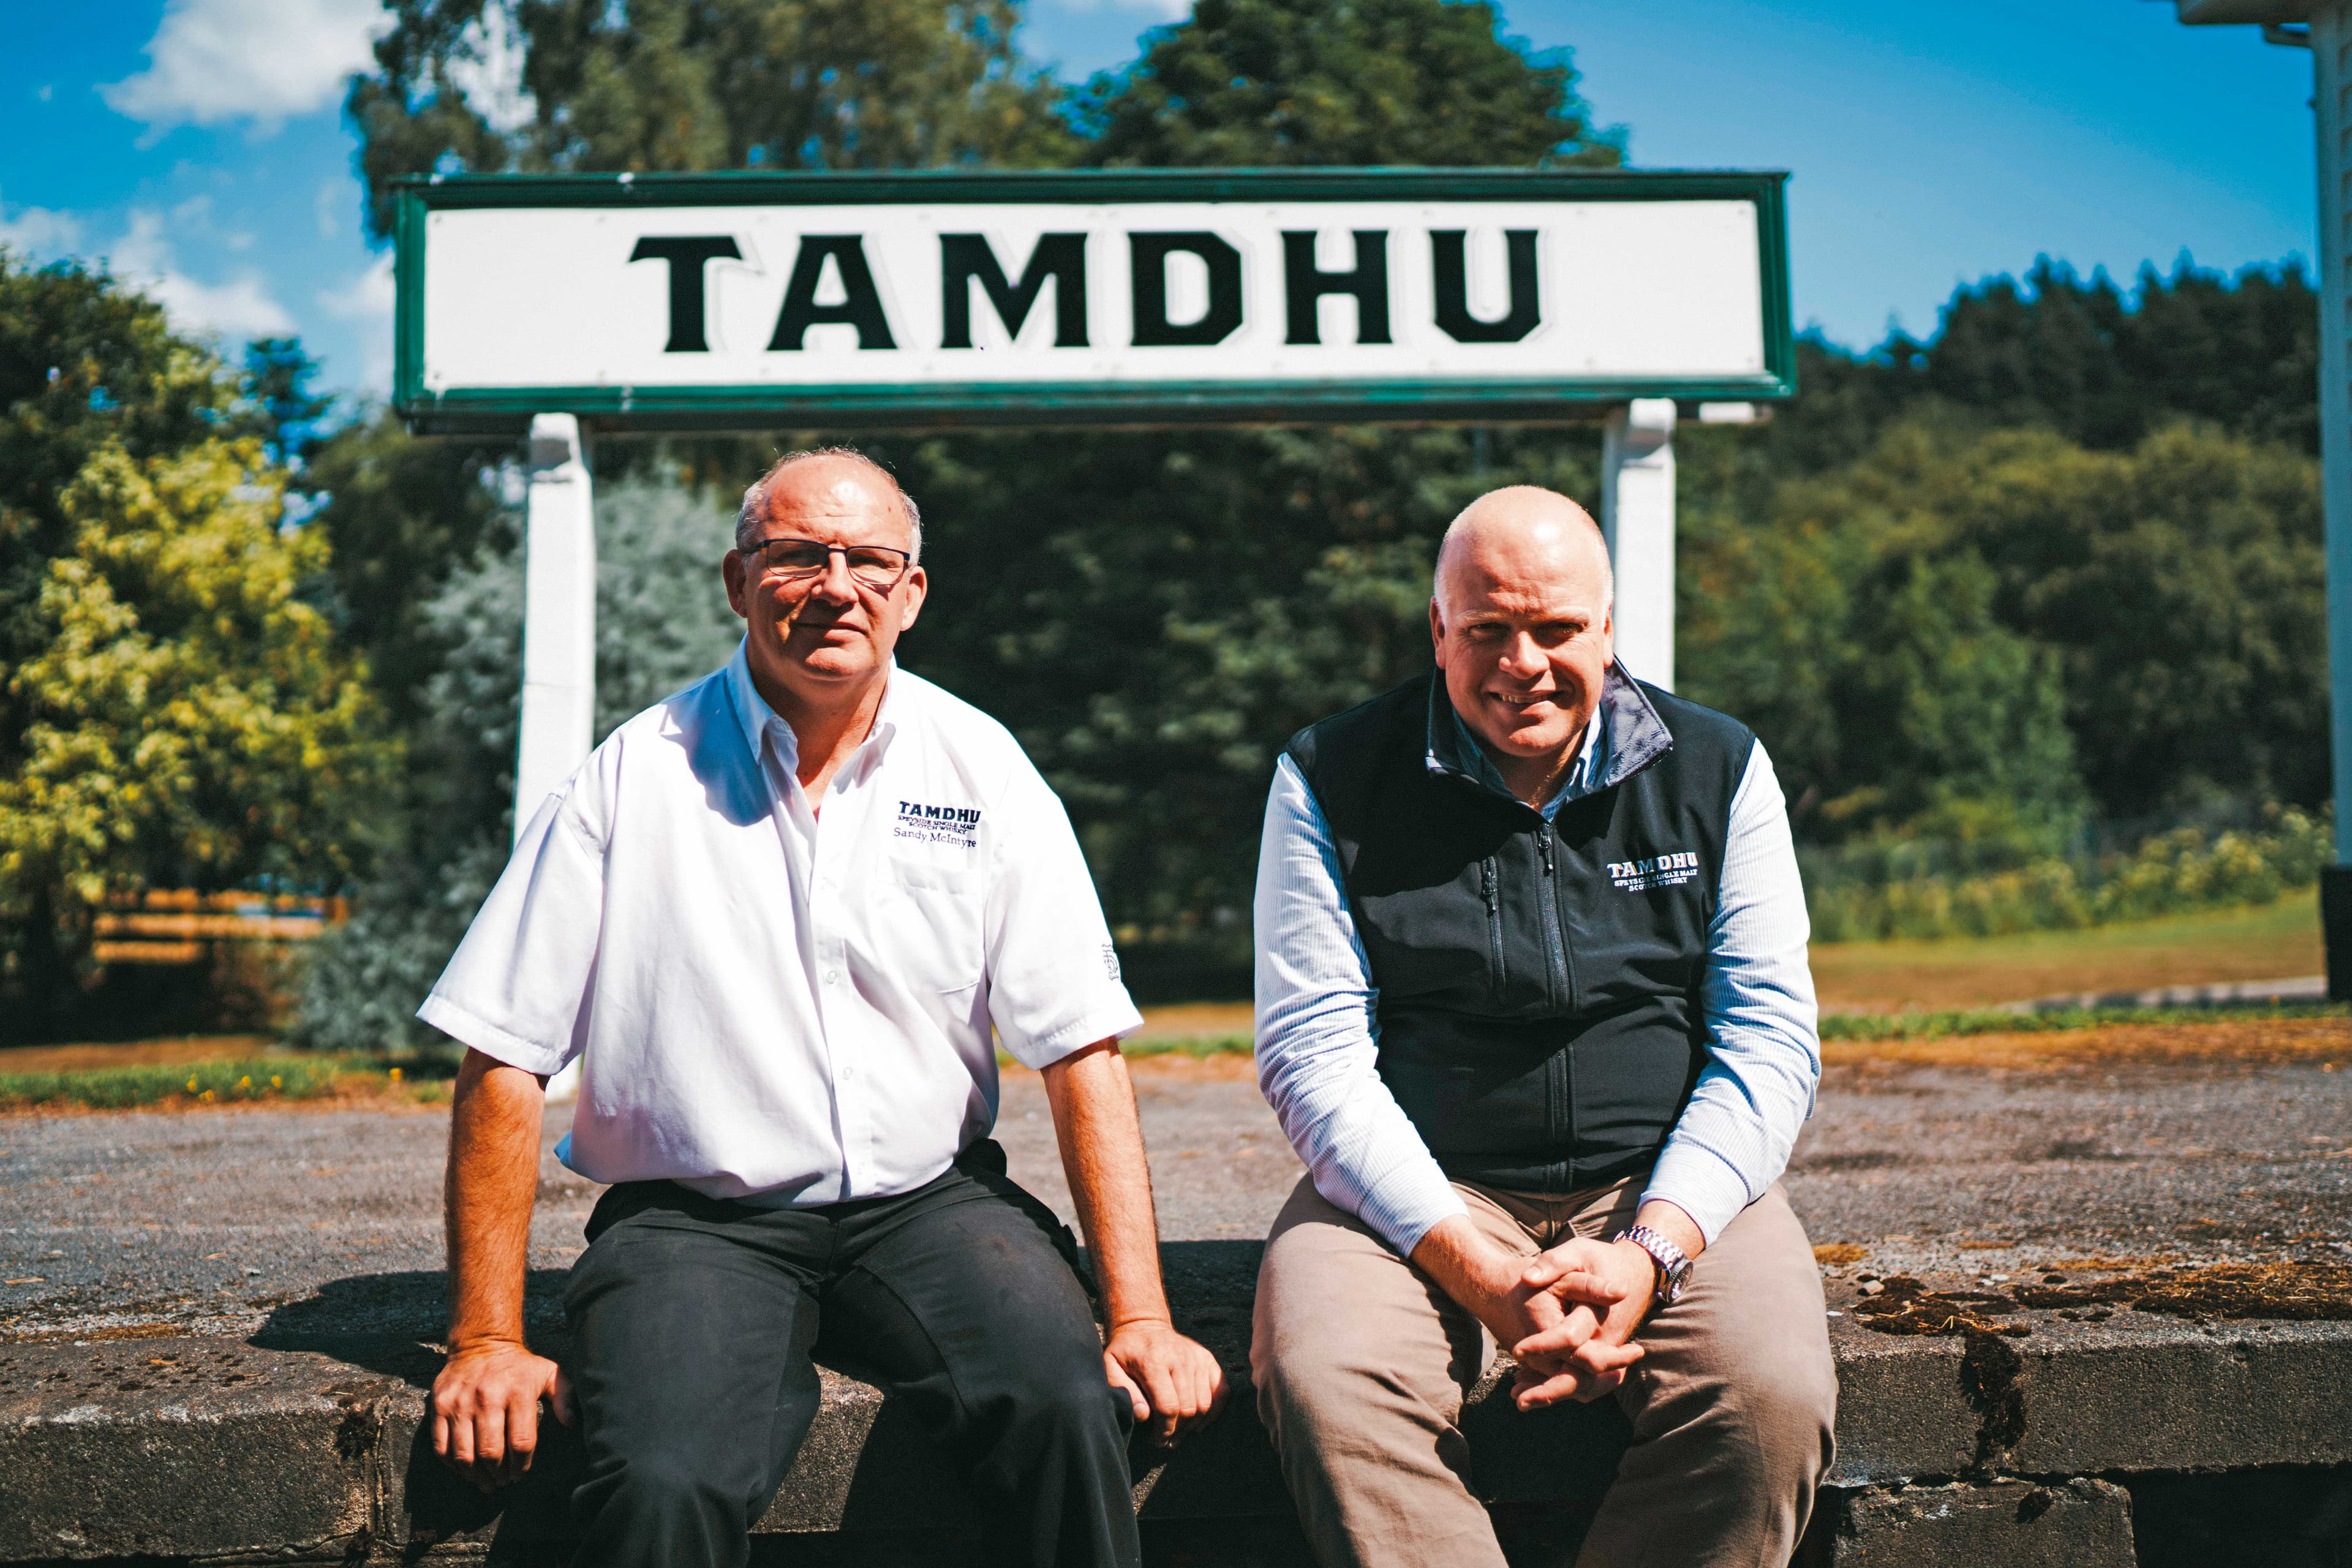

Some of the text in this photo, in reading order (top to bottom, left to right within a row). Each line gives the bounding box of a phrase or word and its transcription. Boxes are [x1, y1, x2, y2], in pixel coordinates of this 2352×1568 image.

[630, 229, 1541, 353] TAMDHU
[898, 815, 932, 826] SPEYSIDE
[899, 801, 981, 823] TAMDHU
[908, 821, 967, 835] SCOTCH WHISKY
[894, 827, 976, 849] Sandy McIntyre
[1607, 852, 1698, 878] TAMDHU
[1614, 877, 1651, 887] SPEYSIDE
[1652, 870, 1679, 881] SINGLE
[1629, 876, 1688, 892] SCOTCH WHISKY
